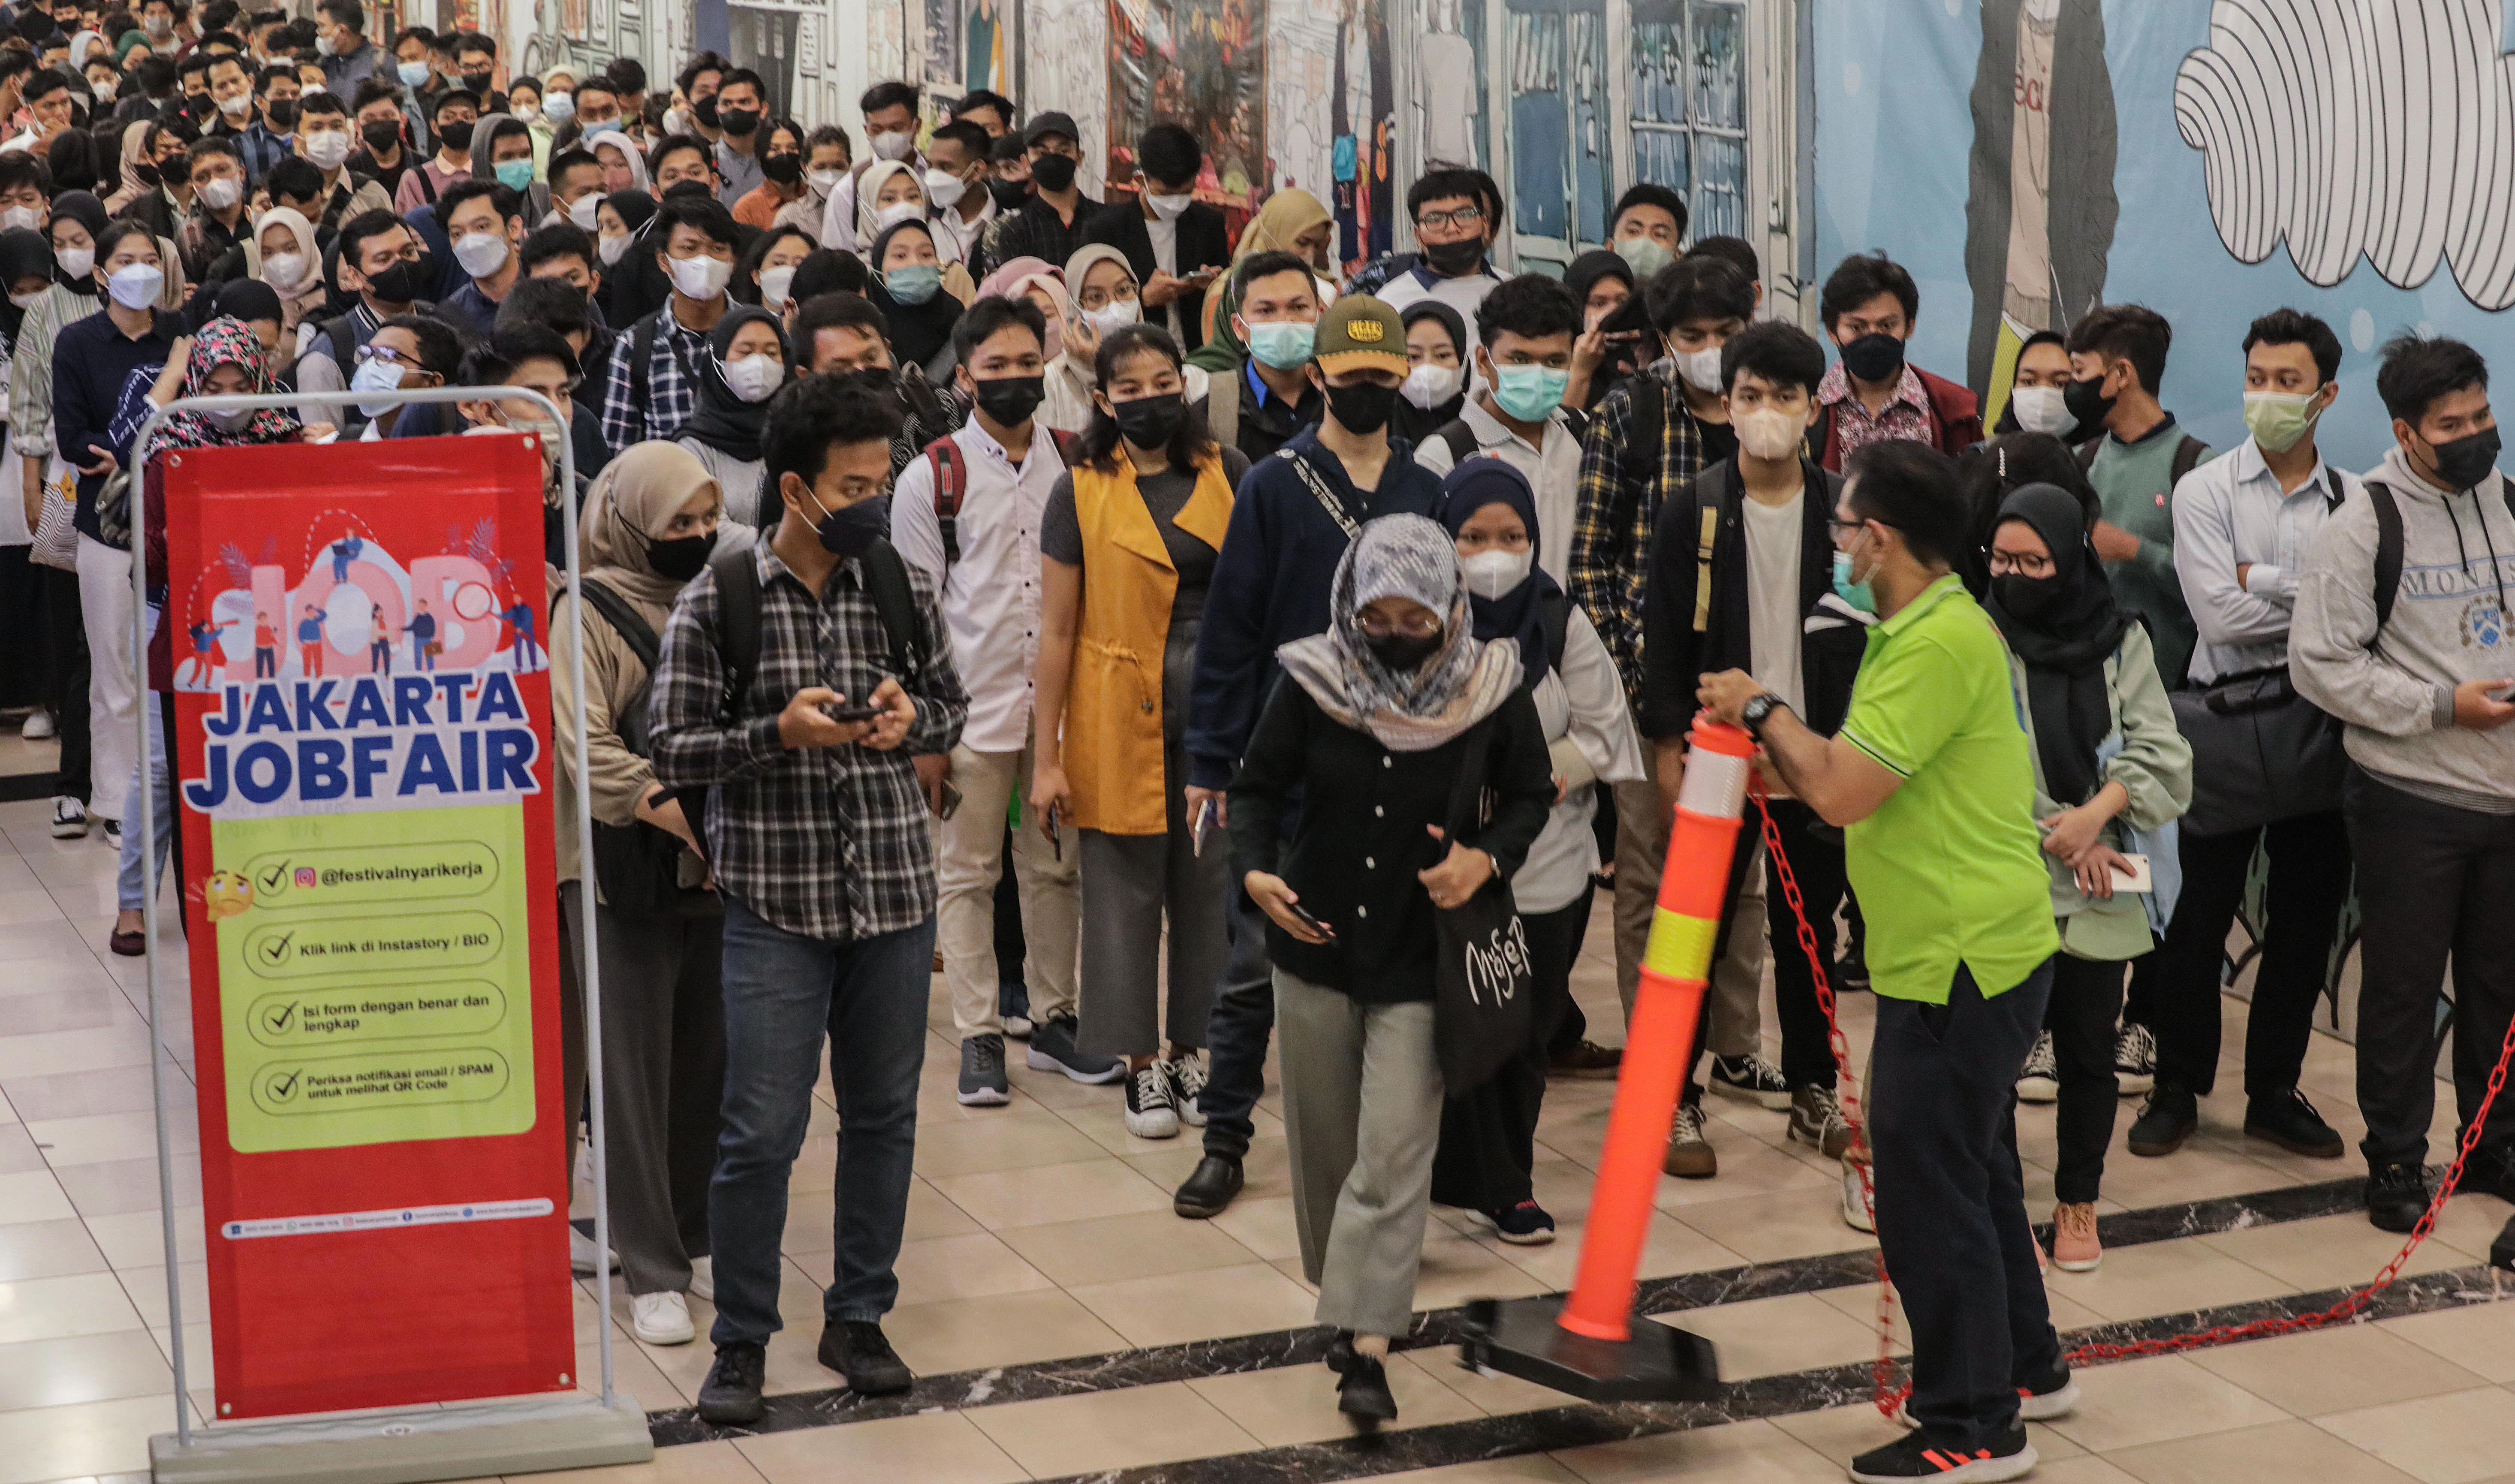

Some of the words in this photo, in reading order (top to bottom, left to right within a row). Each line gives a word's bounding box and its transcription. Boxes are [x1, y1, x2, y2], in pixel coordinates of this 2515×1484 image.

[224, 555, 499, 683] JOB
[207, 672, 524, 736] JAKARTA
[186, 729, 535, 807] JOBFAIR
[321, 862, 482, 886] @festivalnyarikerja
[300, 943, 327, 956] Klik
[331, 941, 357, 954] link
[361, 941, 374, 953] di
[378, 938, 449, 952] Instastory
[462, 933, 489, 947] BIO
[303, 1006, 320, 1017] Isi
[324, 1003, 357, 1015] form
[361, 1001, 414, 1014] dengan
[418, 998, 458, 1010] benar
[463, 995, 489, 1007] dan
[304, 1018, 360, 1033] lengkap
[307, 1073, 352, 1087] Periksa
[356, 1069, 411, 1082] notifikasi
[415, 1067, 447, 1078] email
[458, 1063, 494, 1076] SPAM
[307, 1087, 342, 1099] untuk
[346, 1083, 390, 1096] melihat
[393, 1080, 412, 1092] QR
[416, 1079, 448, 1090] Code
